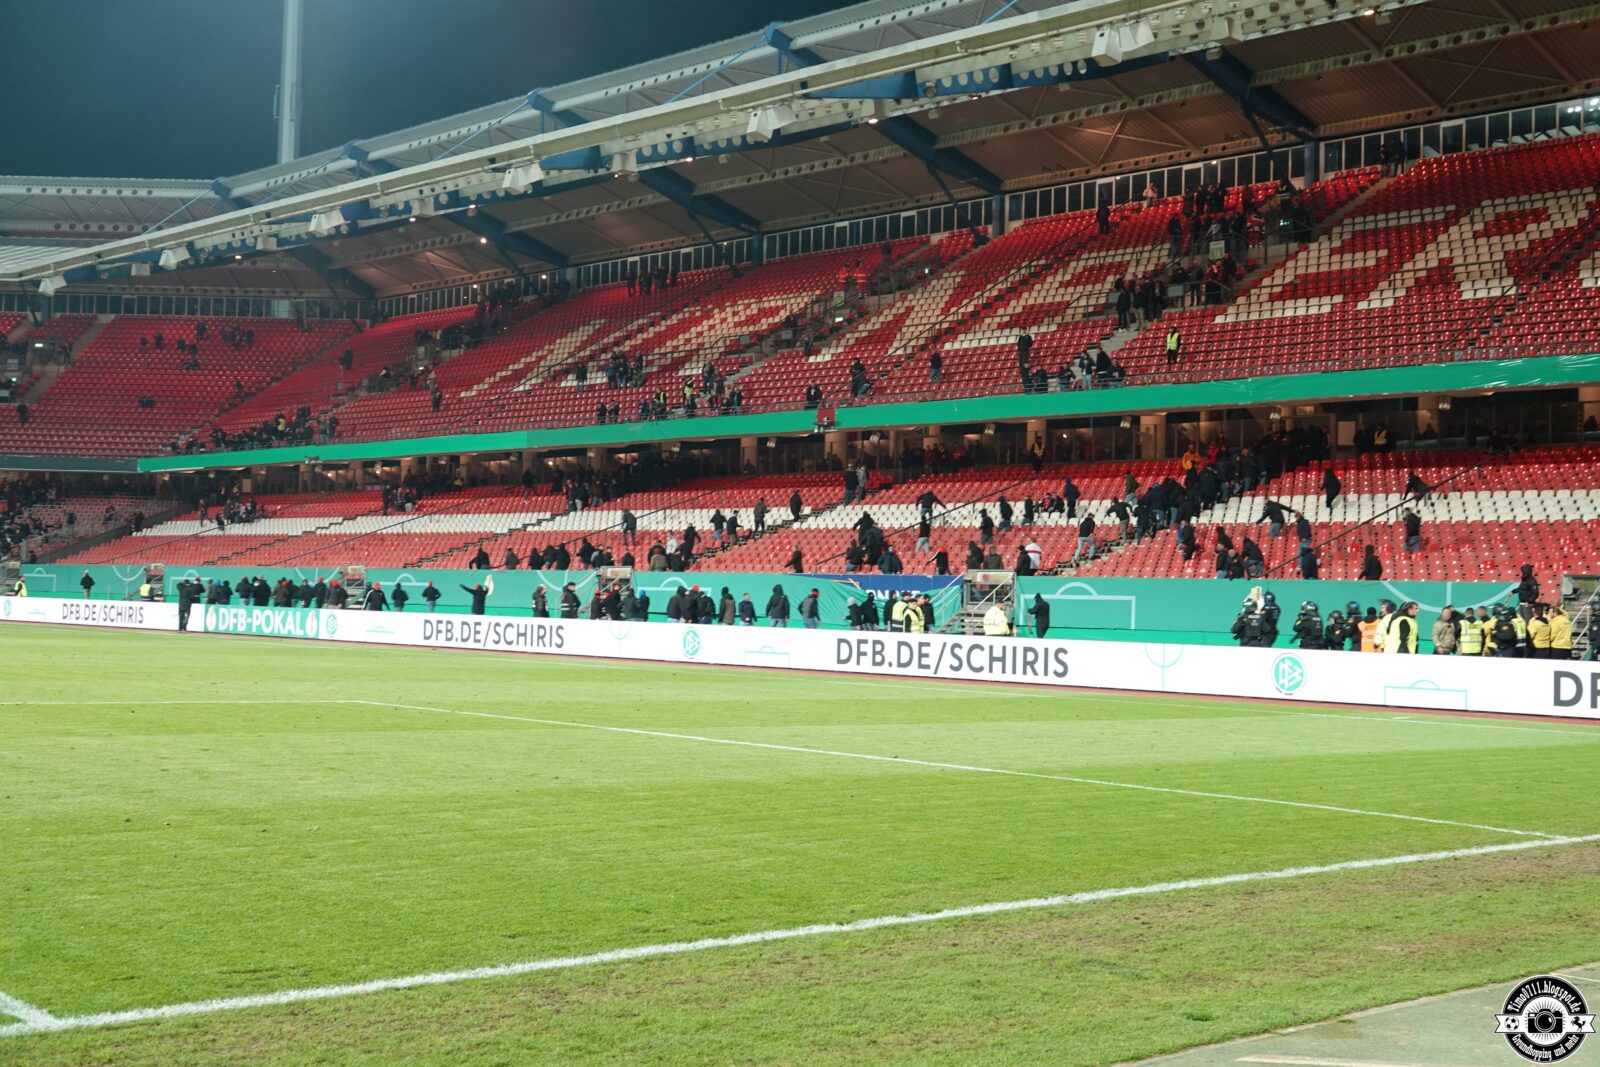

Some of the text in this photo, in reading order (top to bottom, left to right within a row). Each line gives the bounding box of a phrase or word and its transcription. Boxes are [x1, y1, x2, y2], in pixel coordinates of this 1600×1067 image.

[61, 602, 144, 625] DFB.DE/SCHIRIS
[218, 607, 304, 636] DFB-POKAL
[423, 618, 565, 650] DFB.DE/SCHIRIS
[836, 637, 1069, 678] DFB.DE/SCHIRIS
